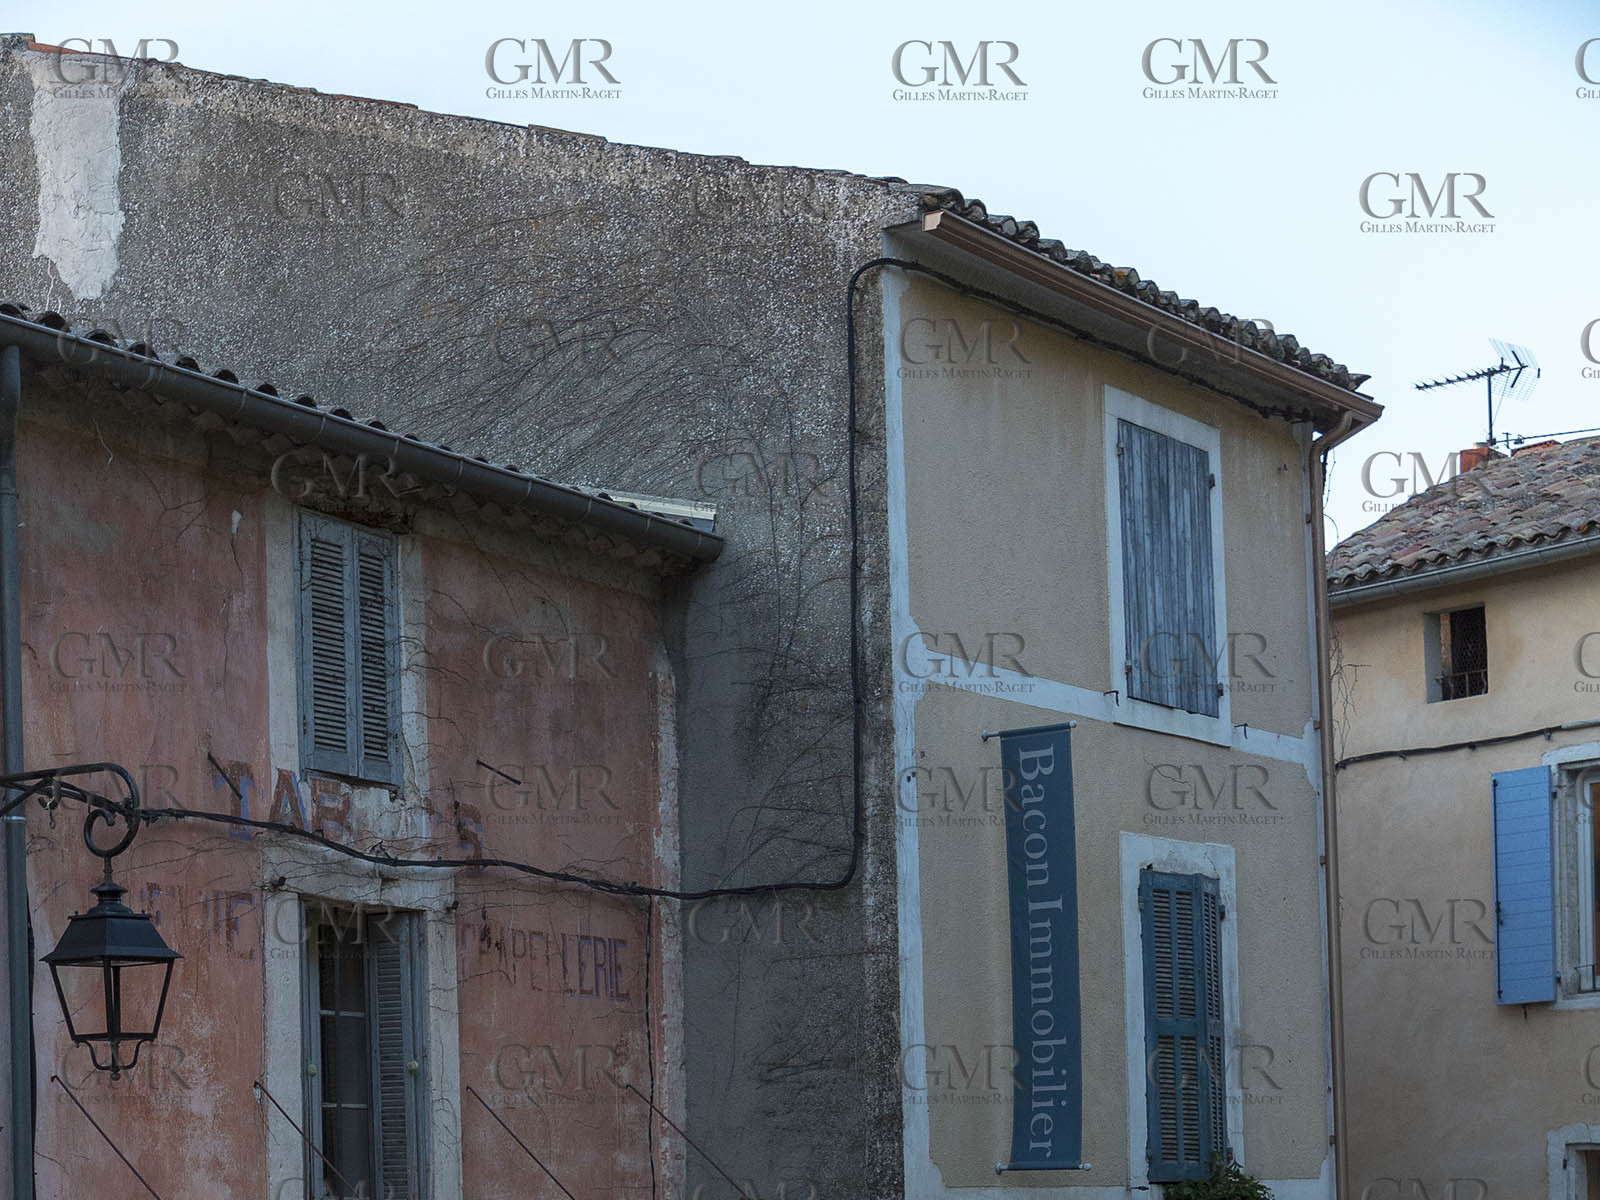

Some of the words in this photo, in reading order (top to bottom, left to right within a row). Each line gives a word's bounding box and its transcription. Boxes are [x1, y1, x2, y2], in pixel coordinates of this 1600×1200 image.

[211, 760, 485, 877] TABS
[1018, 744, 1055, 888] Bacon
[1026, 896, 1067, 1158] Immobilier
